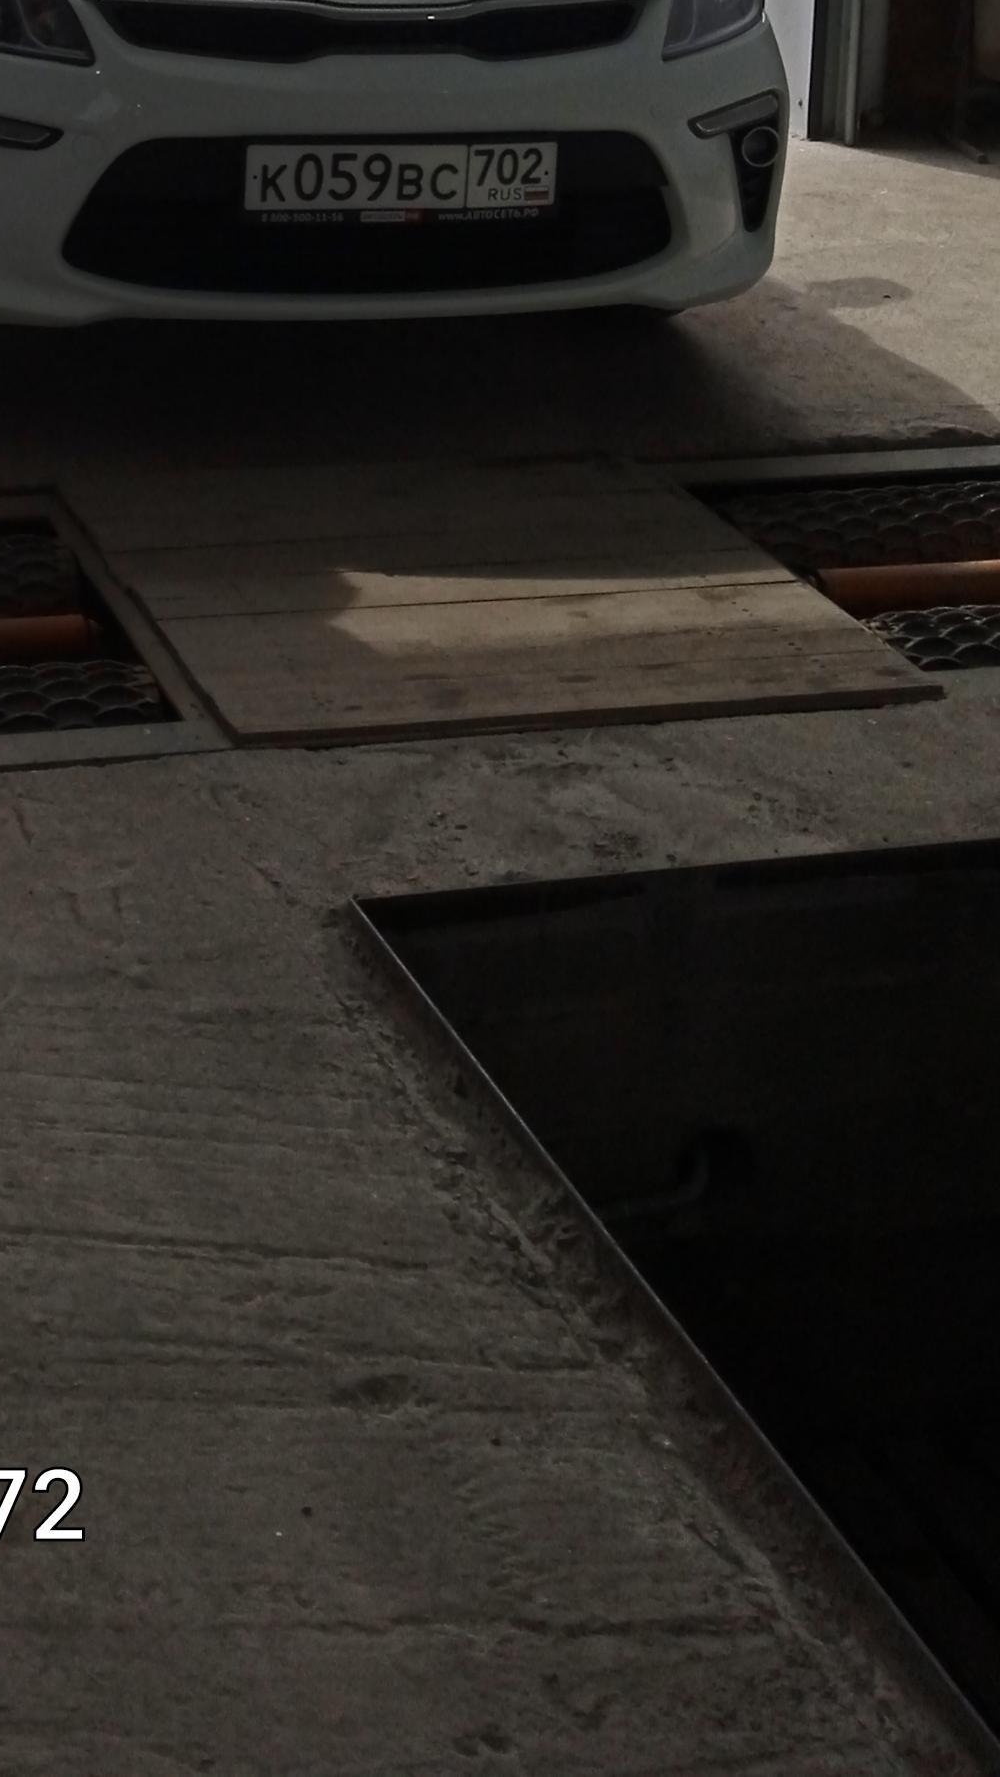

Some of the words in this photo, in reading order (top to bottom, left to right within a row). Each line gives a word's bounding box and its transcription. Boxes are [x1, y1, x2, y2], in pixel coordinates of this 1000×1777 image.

[260, 153, 459, 202] К059ВС
[474, 148, 544, 187] 702
[488, 188, 523, 201] RUS
